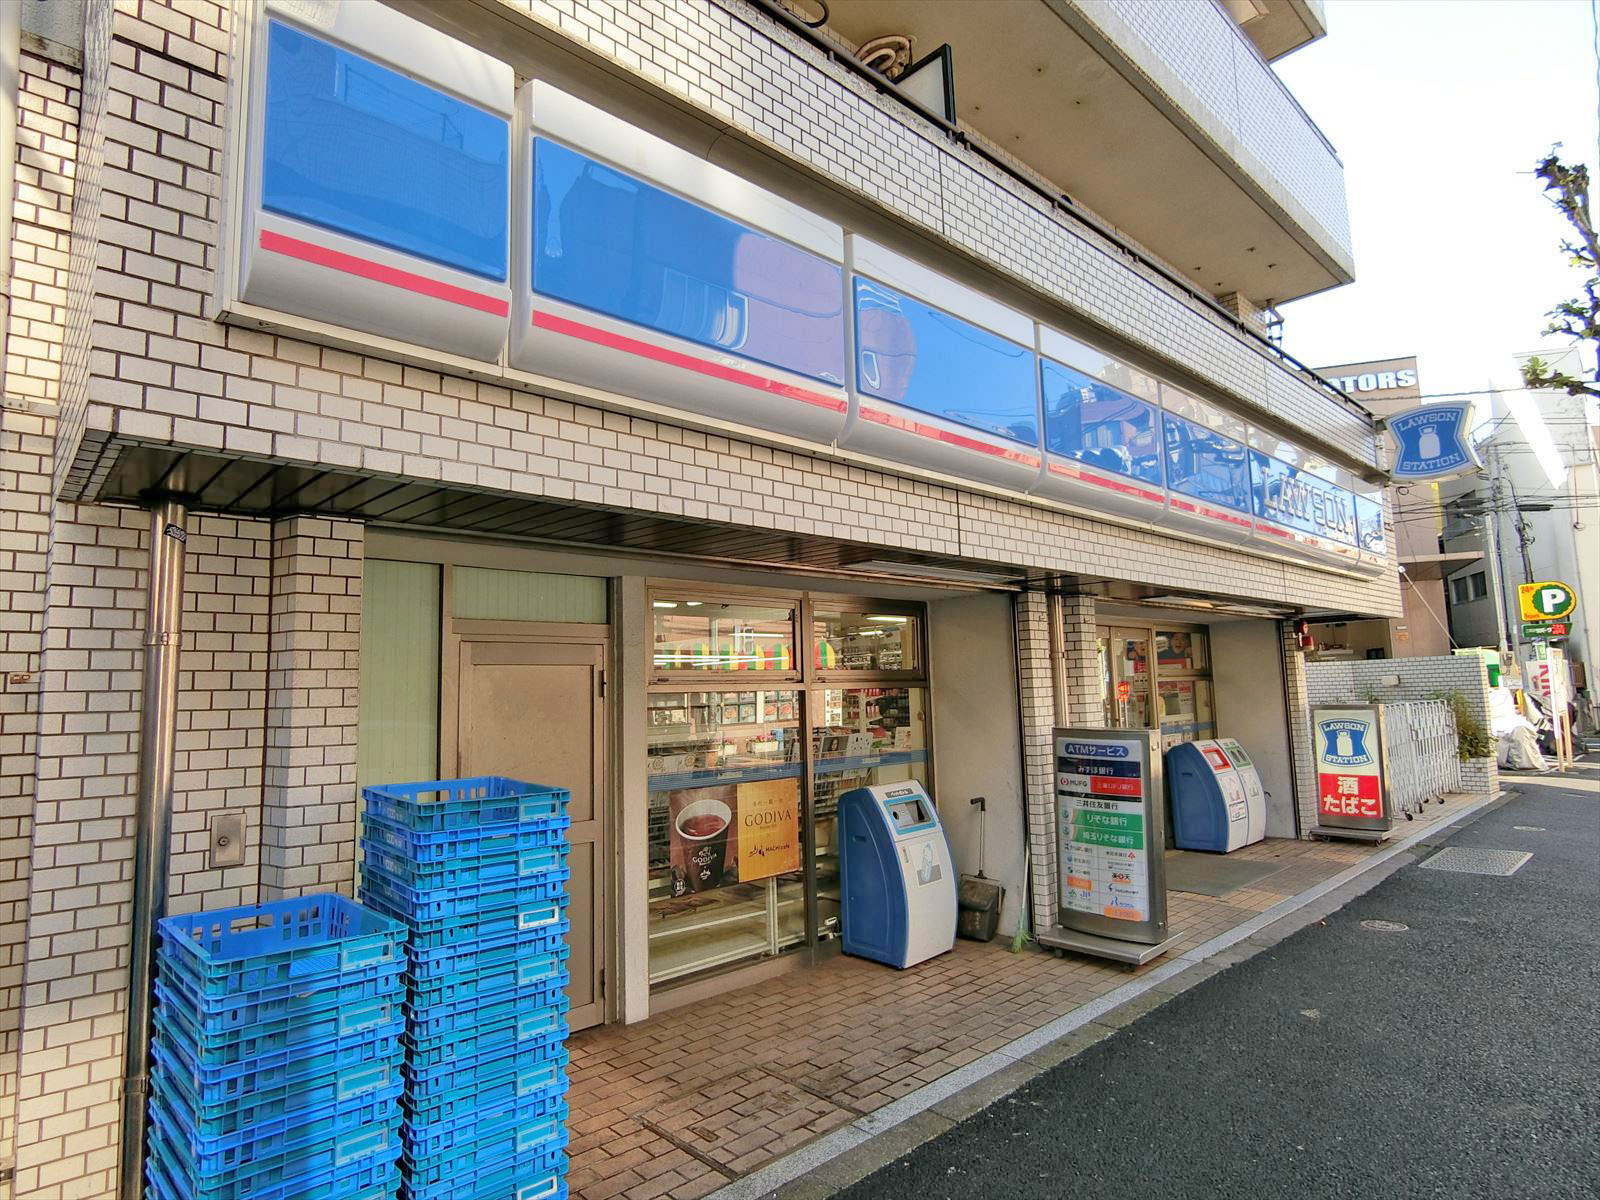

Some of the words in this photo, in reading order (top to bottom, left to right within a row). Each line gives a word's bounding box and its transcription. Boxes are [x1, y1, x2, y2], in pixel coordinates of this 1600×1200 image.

[1399, 412, 1457, 431] LAWSON
[1402, 453, 1461, 471] STATION
[1261, 465, 1349, 535] LAWSON
[1541, 588, 1566, 613] P
[1322, 722, 1365, 732] LAWSON
[1067, 744, 1126, 757] ATMサービス
[1325, 755, 1368, 764] STATION
[1337, 776, 1359, 795] 酒
[1076, 800, 1119, 810] 三井住友銀行
[1323, 794, 1377, 815] たばこ
[744, 809, 791, 827] GODIVA
[1086, 814, 1127, 826] りそな銀行
